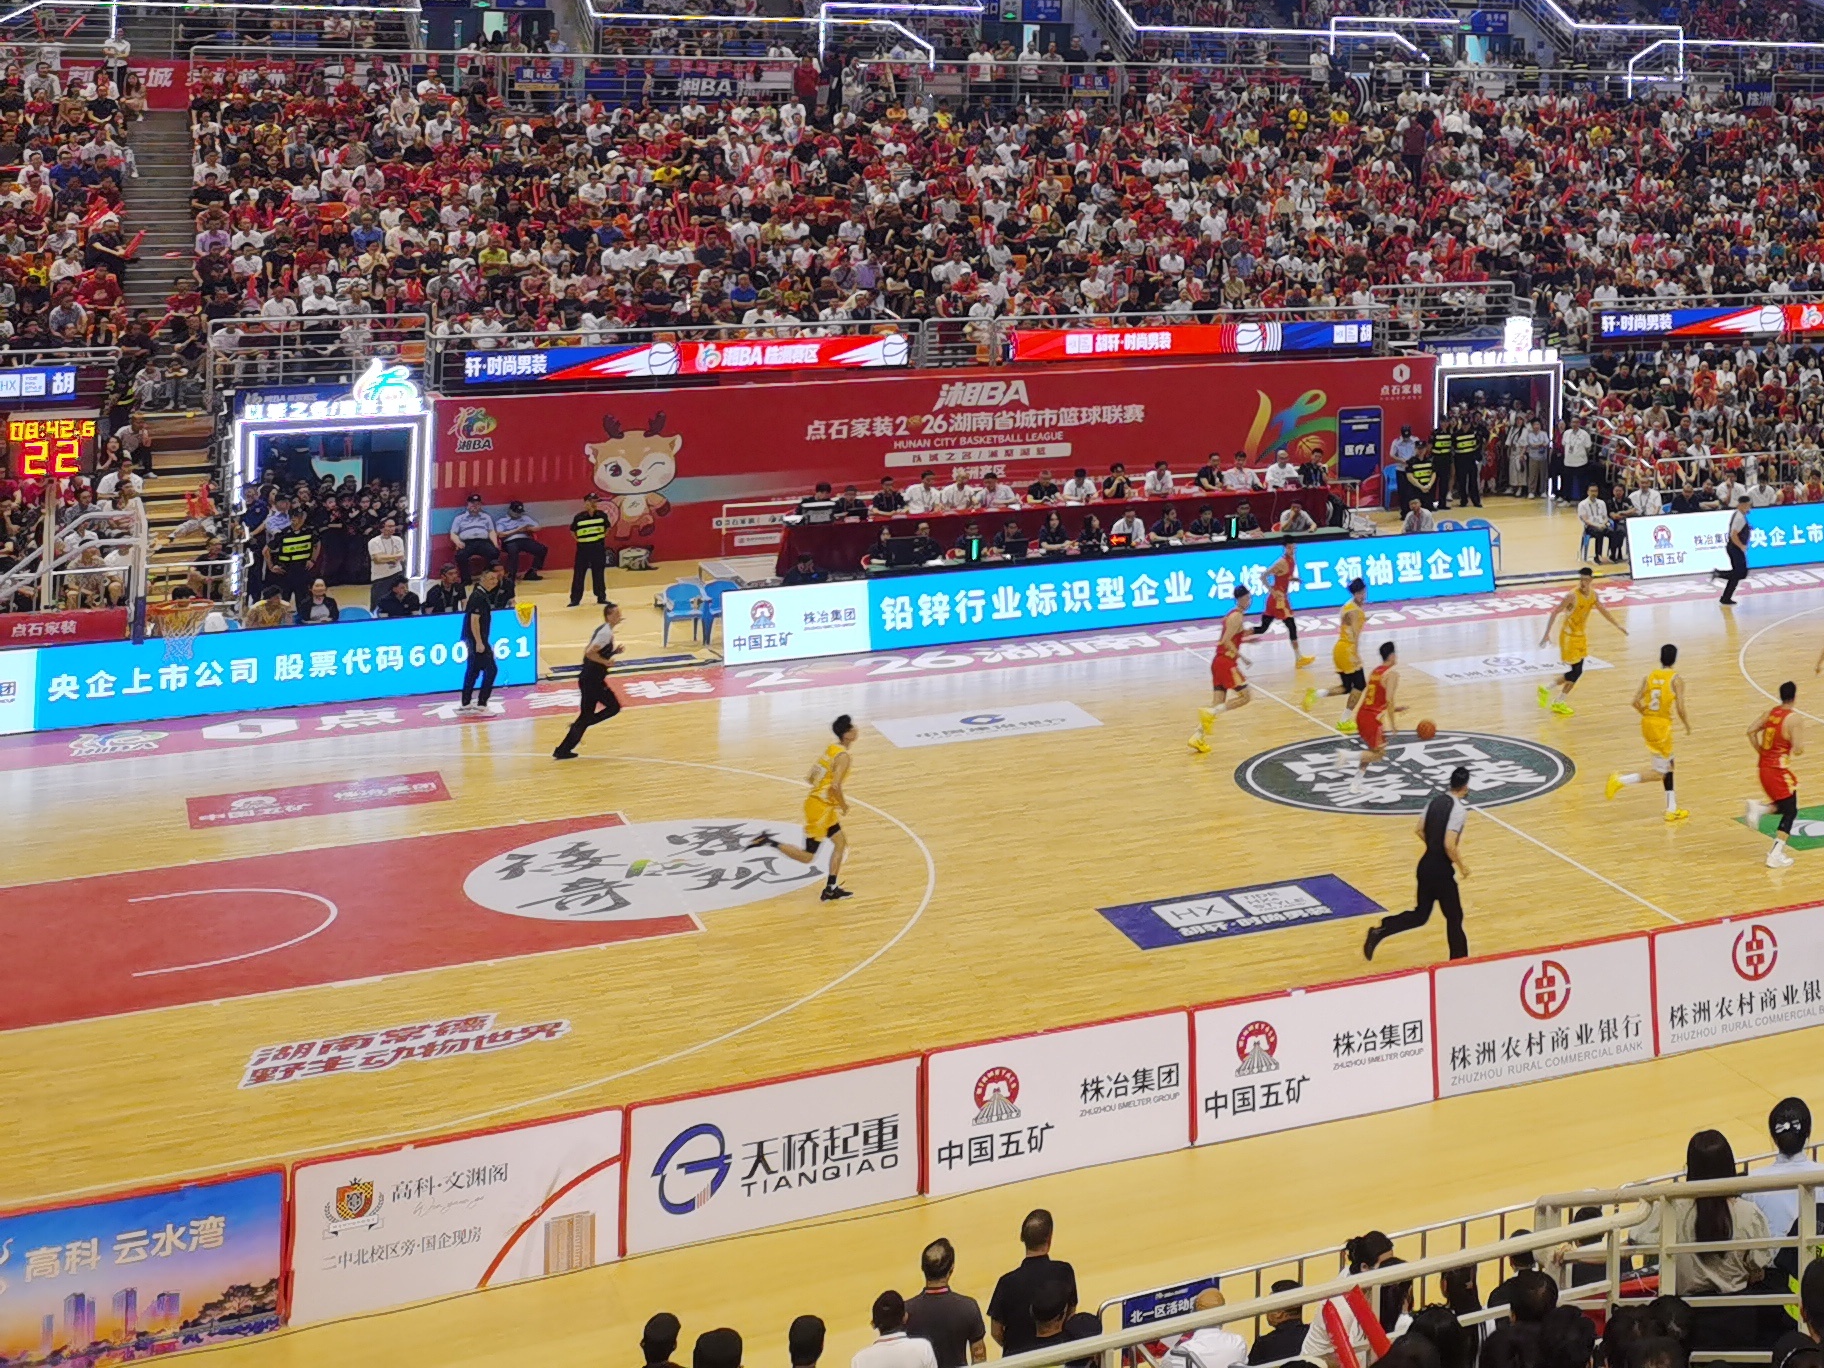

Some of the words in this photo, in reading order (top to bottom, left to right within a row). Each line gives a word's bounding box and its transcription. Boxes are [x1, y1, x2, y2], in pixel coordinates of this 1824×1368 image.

[1601, 312, 1673, 332] 轩·时尚男装
[722, 346, 763, 365] 湘BA
[1095, 331, 1172, 352] 胡轩·时尚男装
[465, 352, 547, 377] 轩·时尚男装
[52, 372, 76, 394] 胡
[933, 380, 1030, 412] 湘BA
[1380, 384, 1423, 397] 点石家装
[9, 420, 96, 442] 08:42.6
[456, 436, 493, 452] 湘BA
[893, 439, 931, 449] HUNAN
[934, 437, 957, 447] CITY
[960, 434, 1022, 446] BASKETBALL
[1026, 431, 1064, 442] LEAGUE
[24, 440, 80, 475] 22
[1344, 443, 1376, 456] 医疗点
[1641, 551, 1688, 567] 中国五矿
[880, 568, 1193, 631] 铅锌行业标识型企业
[1207, 545, 1485, 600] 冶炼工领袖型企业
[11, 620, 77, 638] 点石家装
[803, 608, 856, 625] 株冶集团
[733, 632, 793, 651] 中国五矿
[48, 657, 258, 702] 央企上市公司
[274, 636, 531, 682] 股票代码60061
[1170, 904, 1220, 919] HX
[253, 1013, 492, 1066] 湖南常德
[1332, 1019, 1424, 1058] 株冶集团
[1670, 1025, 1715, 1043] ZHUZHOU
[1721, 1018, 1753, 1034] RURAL
[1755, 1008, 1815, 1028] COMMERCIAL
[249, 1020, 565, 1086] 野生动物世界
[1449, 1013, 1643, 1072] 株洲农村商业银行
[1333, 1056, 1366, 1071] ZHUZHOU
[1367, 1051, 1400, 1066] SMELTER
[1401, 1047, 1425, 1060] GROUP
[1450, 1067, 1503, 1086] ZHUZHOU
[1508, 1059, 1542, 1075] RURAL
[1544, 1048, 1613, 1069] COMMERCIAL
[1616, 1041, 1644, 1056] BANK
[1079, 1062, 1180, 1103] 株冶集团
[1204, 1075, 1311, 1120] 中国五矿
[1078, 1103, 1116, 1118] ZHUZHOU
[1118, 1097, 1152, 1112] SMELTER
[1154, 1092, 1181, 1105] GROUP
[740, 1114, 900, 1181] 天桥起重
[937, 1121, 1056, 1173] 中国五矿
[391, 1162, 510, 1203] 高科·文渊阁
[741, 1153, 899, 1197] TIANQIAO
[24, 1238, 101, 1282] 高科
[113, 1214, 227, 1265] 云水湾
[321, 1225, 484, 1272] 二中北校区旁·国企现房
